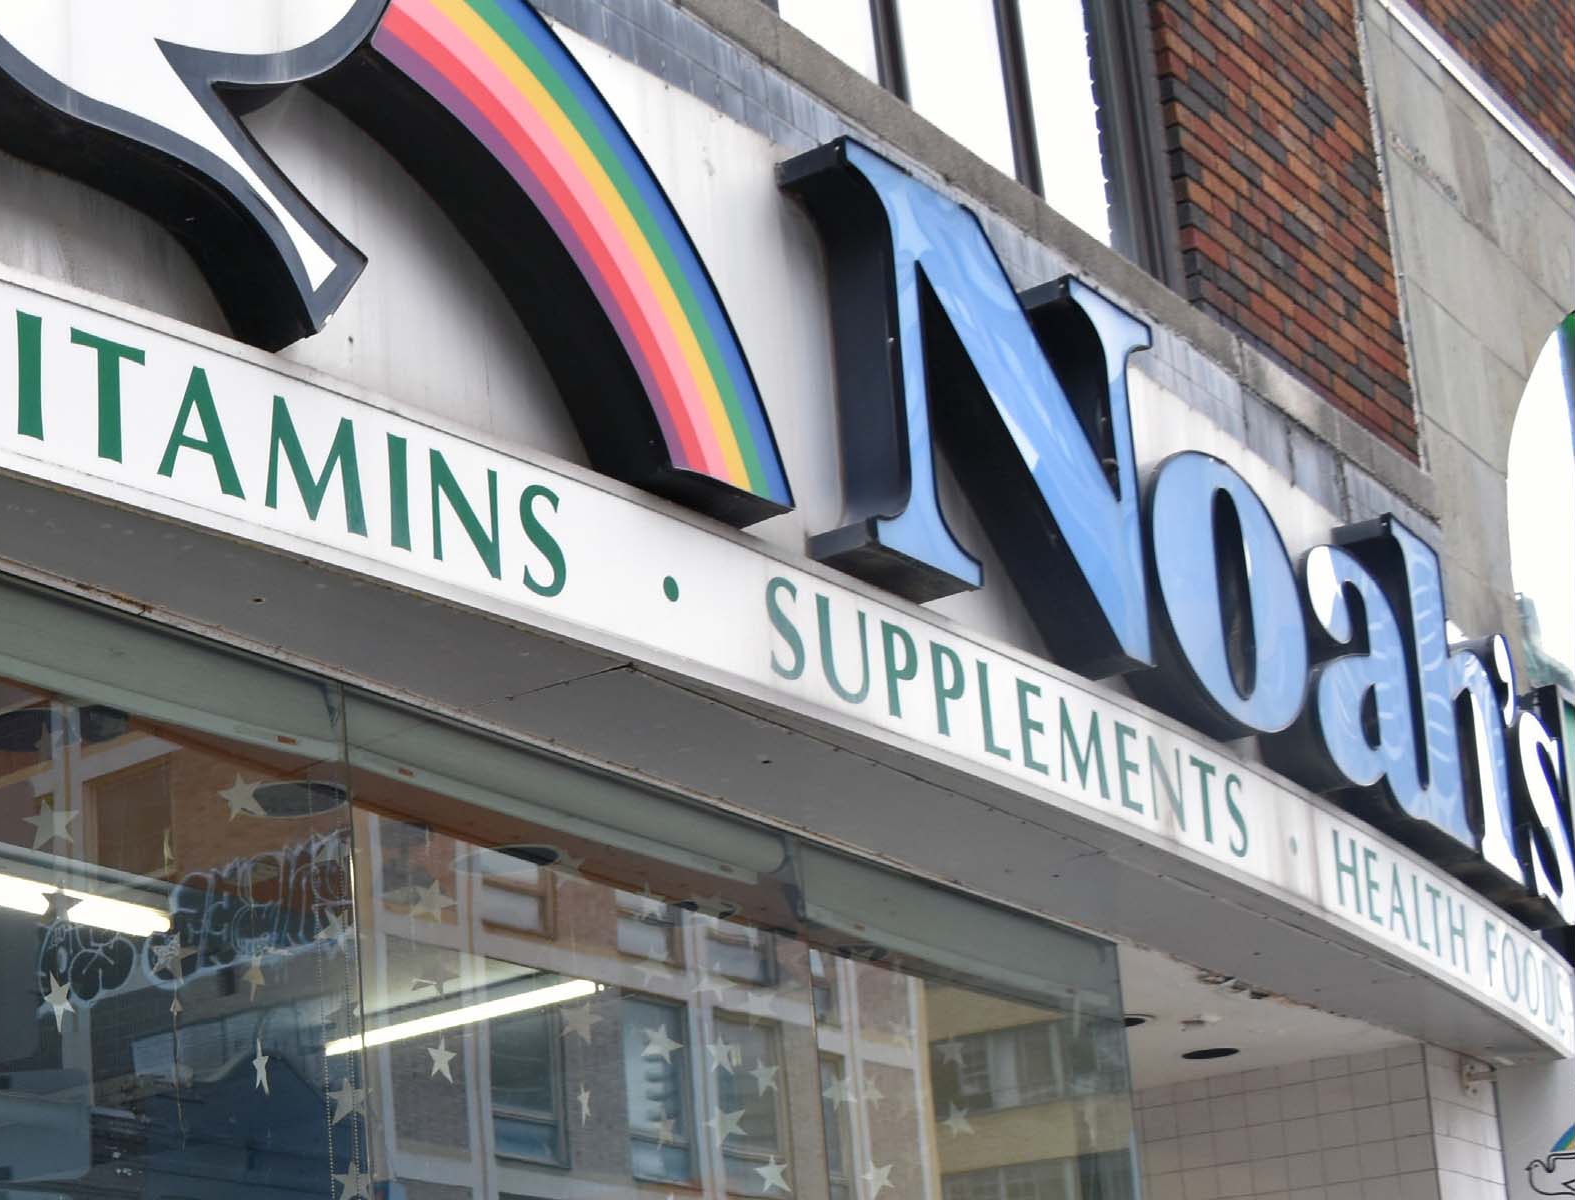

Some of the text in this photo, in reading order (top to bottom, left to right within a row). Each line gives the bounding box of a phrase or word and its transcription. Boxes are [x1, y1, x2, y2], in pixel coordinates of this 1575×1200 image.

[845, 136, 1575, 925] Noah's
[765, 576, 1250, 859] SUPPLEMENTS
[1332, 830, 1469, 974] HEALTH
